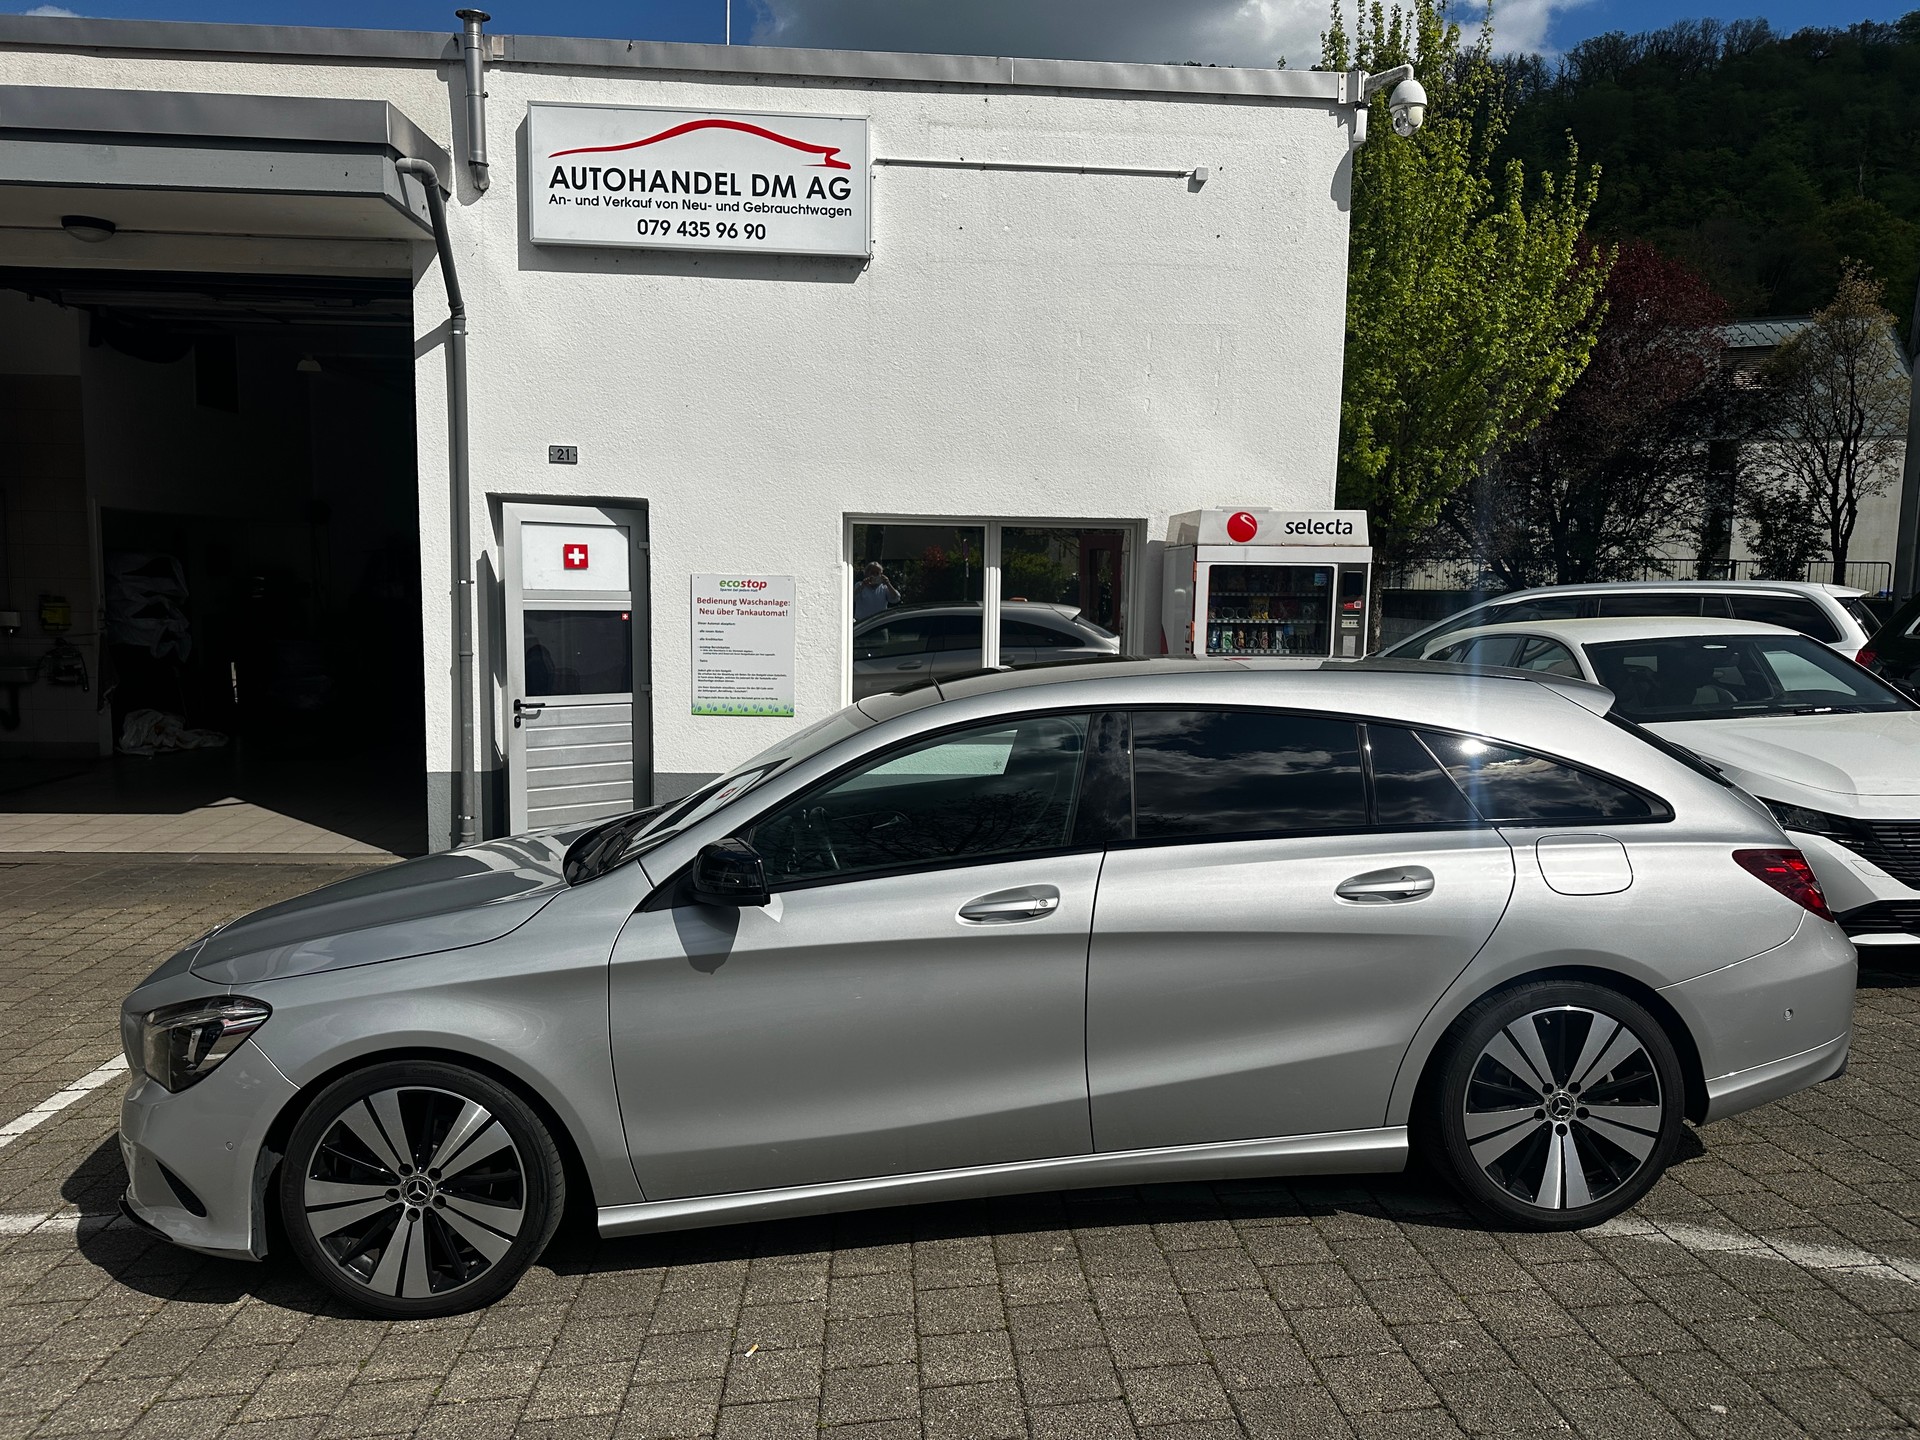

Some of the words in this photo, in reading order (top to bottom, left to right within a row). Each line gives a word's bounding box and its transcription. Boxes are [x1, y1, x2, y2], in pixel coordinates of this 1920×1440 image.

[548, 165, 742, 197] AUTOHANDEL
[751, 173, 797, 199] DM
[805, 175, 852, 201] AG
[548, 193, 572, 206] An-
[575, 195, 600, 207] und
[602, 195, 653, 209] Verkauf
[655, 200, 679, 210] von
[682, 198, 713, 211] Neu-
[715, 201, 740, 213] und
[742, 201, 853, 219] Gebrauchtwagen
[637, 218, 671, 237] 079
[676, 220, 711, 238] 435
[715, 221, 739, 239] 96
[743, 223, 766, 240] 90
[556, 448, 570, 461] 21
[1284, 518, 1353, 535] selecta
[719, 579, 767, 591] ecostop
[696, 597, 738, 606] Bedienung
[738, 598, 790, 608] Waschanlage:
[699, 607, 715, 616] Neu
[716, 608, 735, 617] über
[736, 608, 788, 618] Tankautomat!
